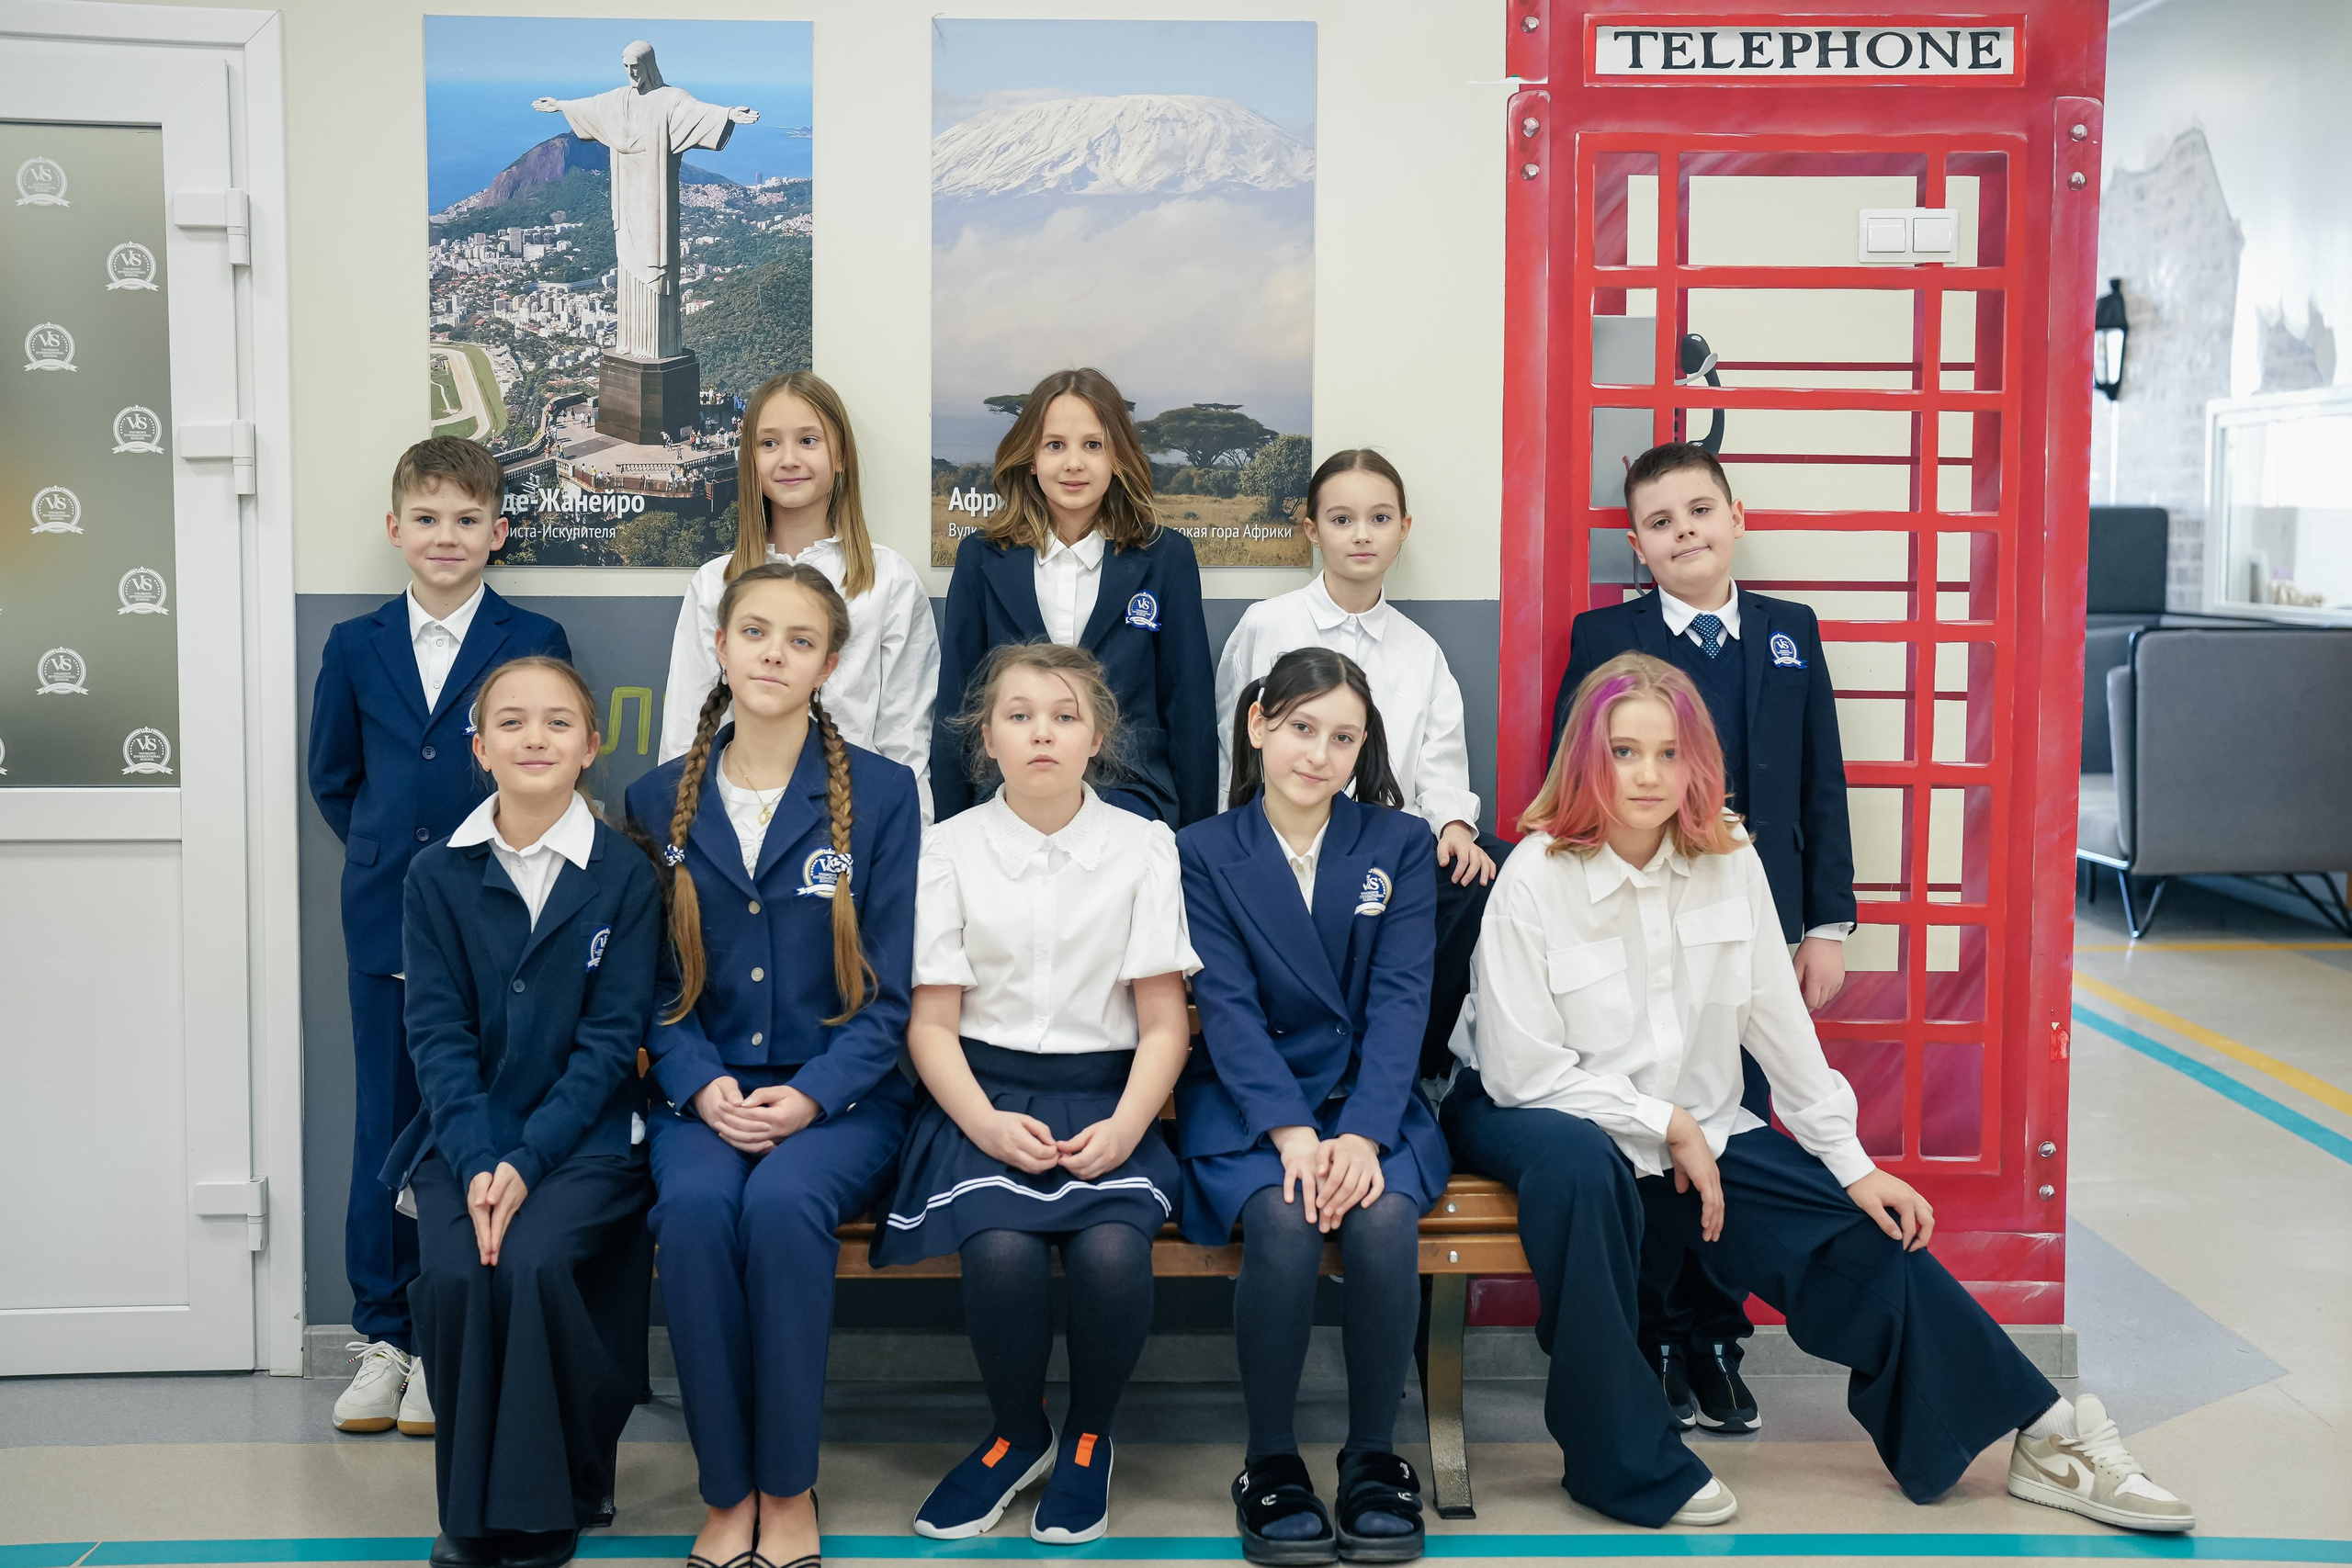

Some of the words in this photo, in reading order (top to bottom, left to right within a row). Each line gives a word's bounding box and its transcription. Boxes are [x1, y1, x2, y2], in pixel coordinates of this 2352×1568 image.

[1614, 31, 2001, 70] TELEPHONE
[501, 488, 645, 518] де-Жанейро
[948, 487, 1008, 517] Афри
[506, 524, 616, 541] иста-Искупителя
[1211, 526, 1239, 541] гора
[1242, 524, 1292, 541] Африки
